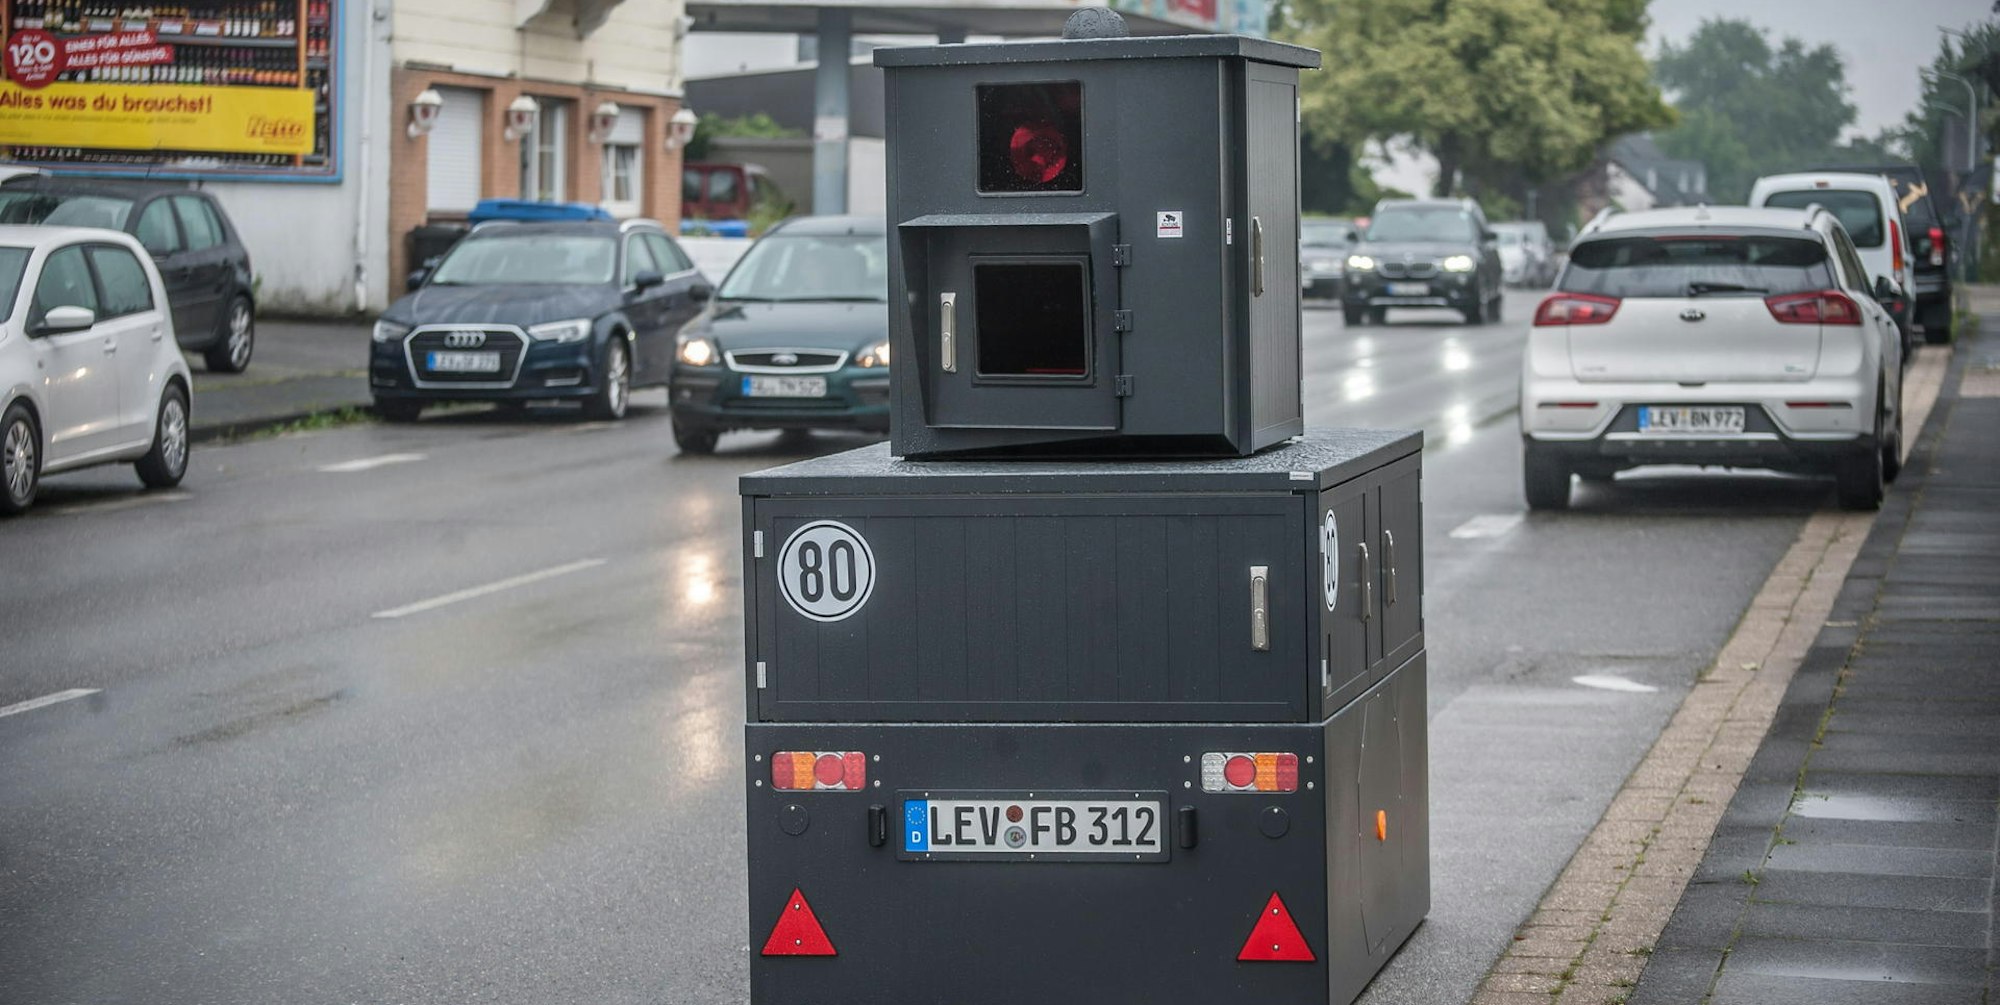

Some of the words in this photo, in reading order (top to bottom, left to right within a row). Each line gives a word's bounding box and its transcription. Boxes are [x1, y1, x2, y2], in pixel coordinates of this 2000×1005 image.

[97, 34, 118, 49] FÜR
[9, 40, 55, 67] 120
[66, 53, 98, 67] ALLES
[99, 50, 119, 64] FÜR
[0, 90, 43, 109] Alles
[50, 95, 87, 111] was
[93, 93, 117, 112] du
[123, 93, 213, 114] brauchst!
[246, 116, 304, 138] Netto
[1650, 407, 1679, 428] LEV
[1690, 408, 1711, 428] BN
[1716, 409, 1744, 428] 972
[798, 539, 857, 603] 80
[1326, 528, 1336, 592] 80
[911, 831, 921, 843] D
[930, 806, 1000, 846] LEV
[1031, 806, 1077, 846] FB
[1088, 806, 1156, 846] 312
